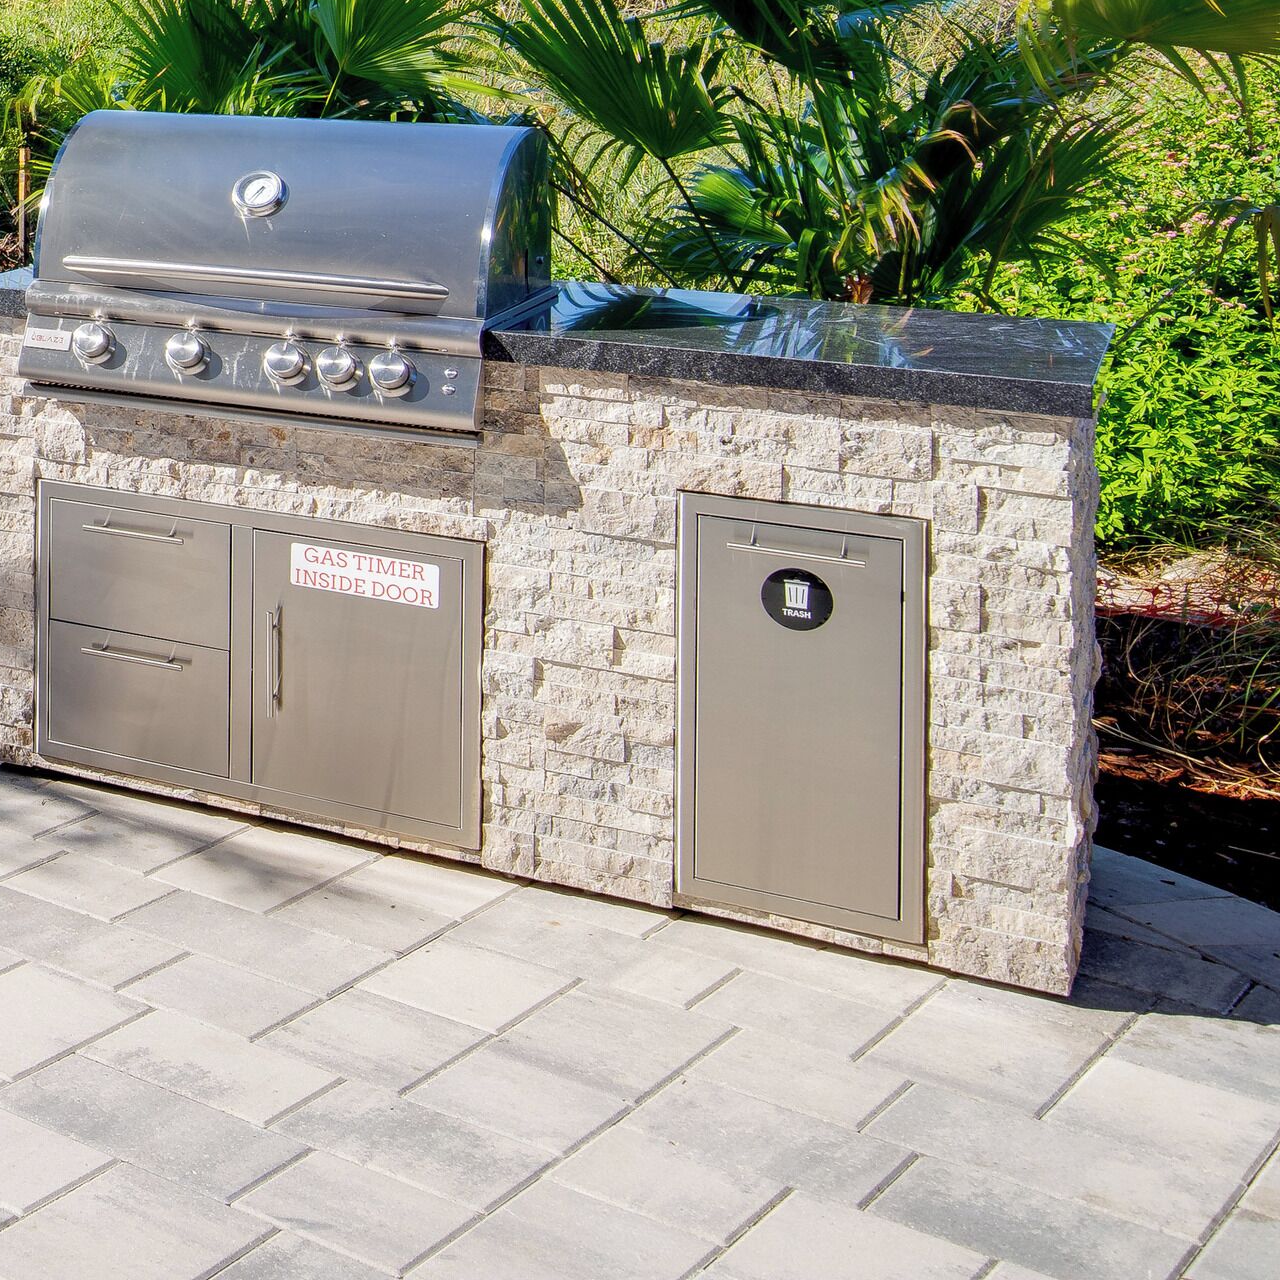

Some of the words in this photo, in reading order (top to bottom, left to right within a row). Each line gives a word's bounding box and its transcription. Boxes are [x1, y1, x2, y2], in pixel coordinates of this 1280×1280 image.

[304, 547, 348, 568] GAS
[353, 554, 425, 581] TIMER
[295, 568, 366, 595] INSIDE
[372, 581, 433, 606] DOOR
[782, 608, 811, 620] TRASH
